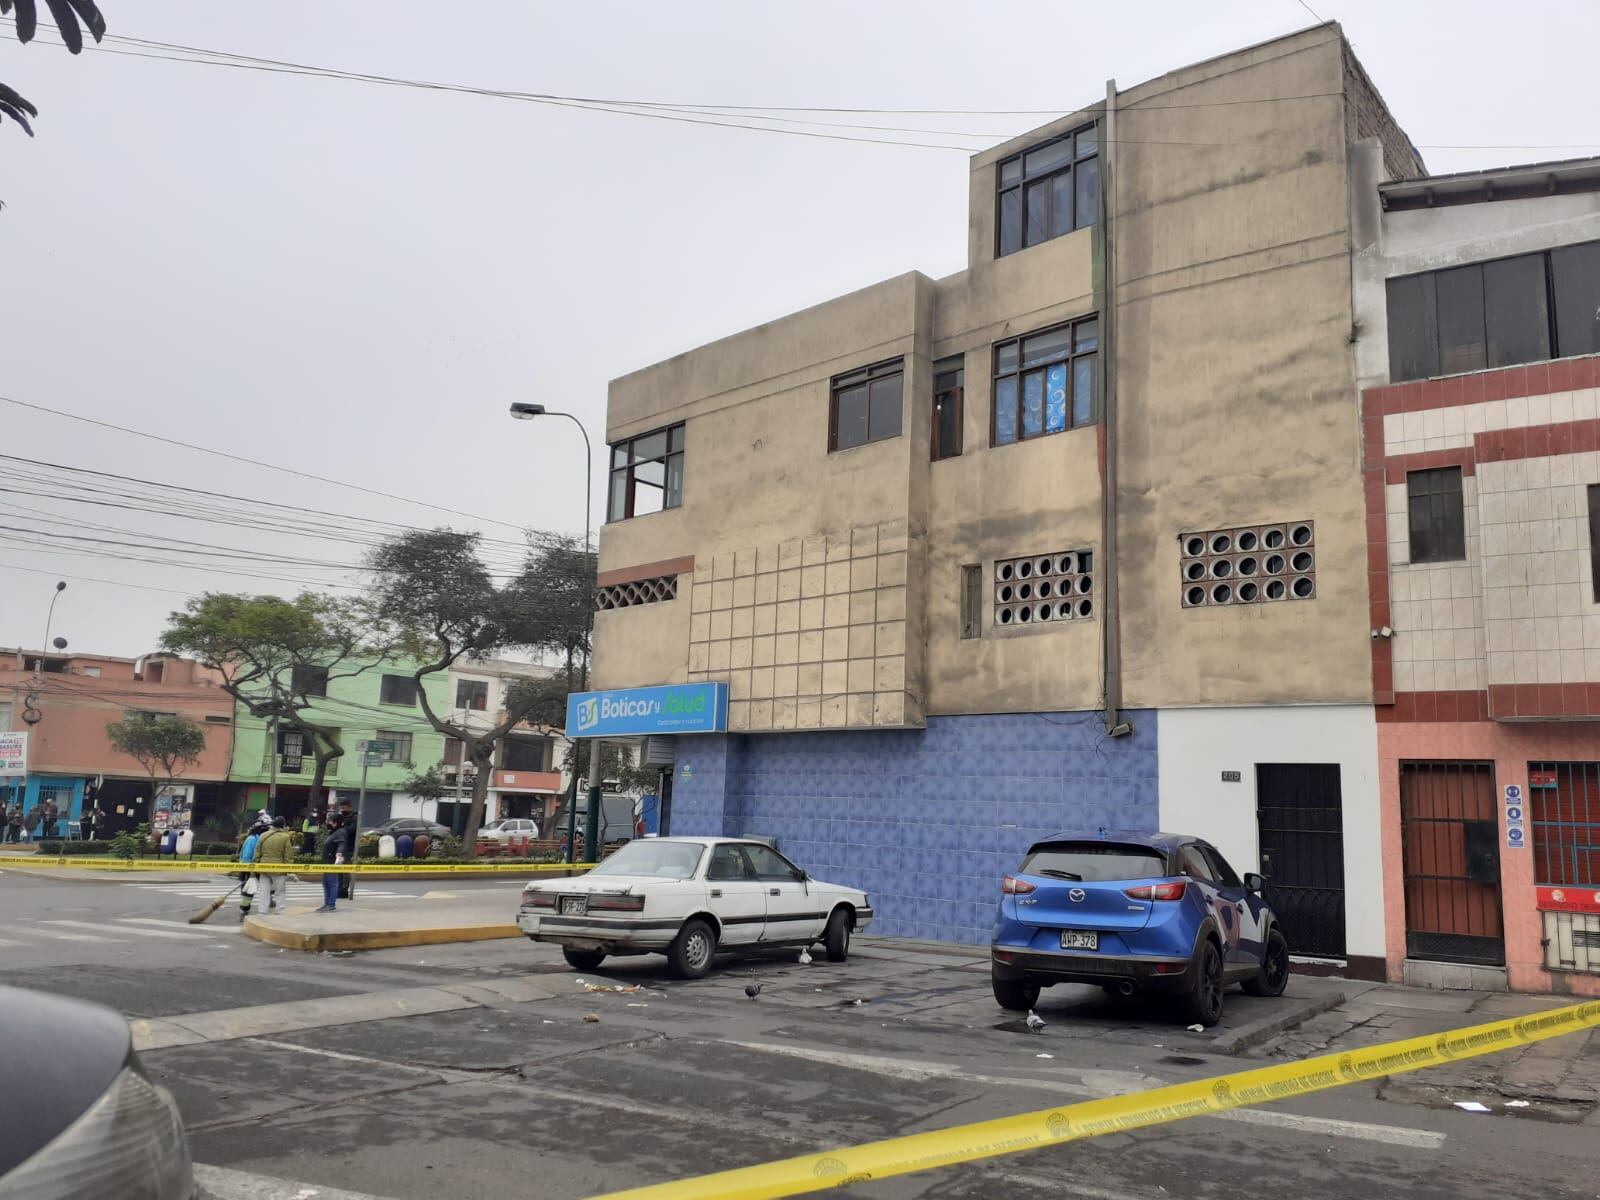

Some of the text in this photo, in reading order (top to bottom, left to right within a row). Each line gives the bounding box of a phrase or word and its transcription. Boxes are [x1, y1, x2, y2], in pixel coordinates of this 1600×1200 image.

[600, 689, 705, 719] Boticas y Salud
[1062, 933, 1096, 947] AWP-378
